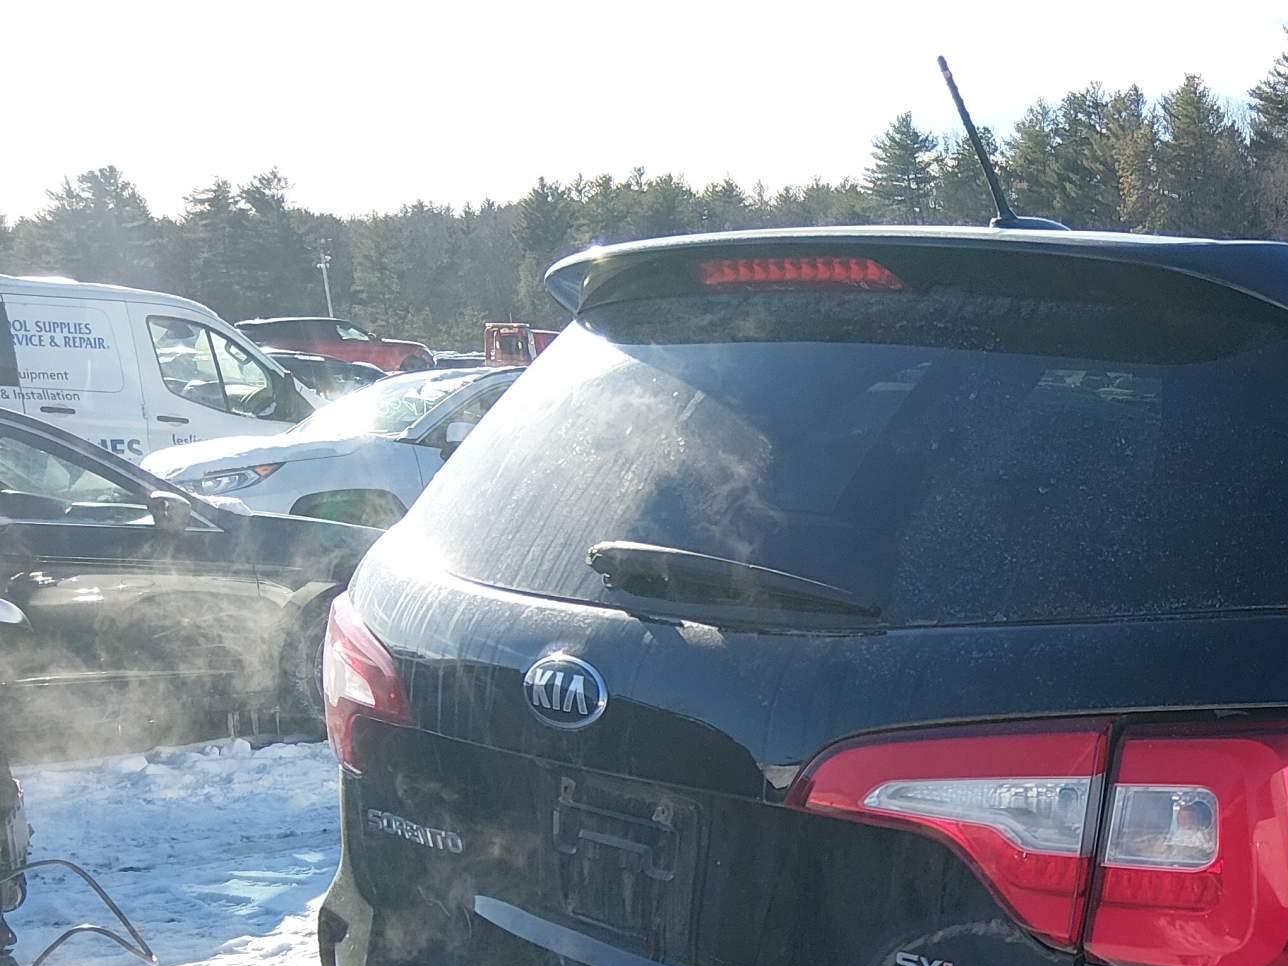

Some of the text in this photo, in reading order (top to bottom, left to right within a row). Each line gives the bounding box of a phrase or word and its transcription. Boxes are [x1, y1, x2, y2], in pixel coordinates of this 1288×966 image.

[11, 319, 92, 335] OL SUPPLIES
[49, 335, 61, 348] &
[17, 370, 70, 383] uipment
[0, 388, 81, 401] & Installation
[532, 667, 588, 715] KIA
[367, 808, 463, 854] SORENTO
